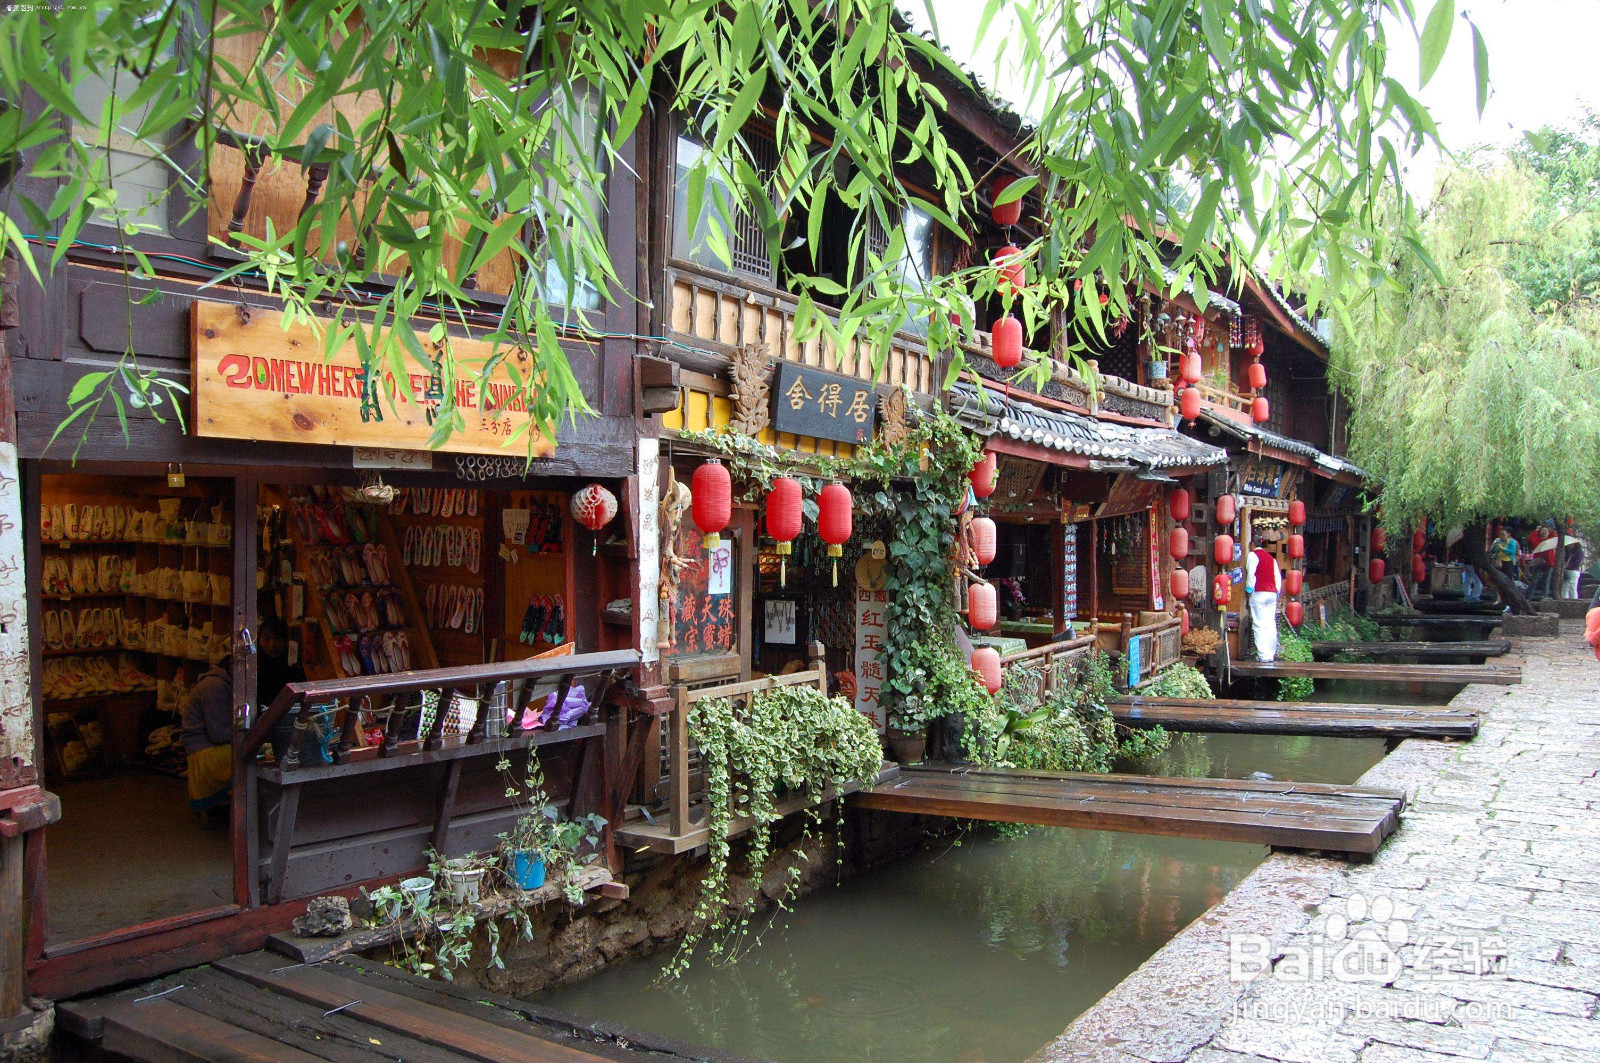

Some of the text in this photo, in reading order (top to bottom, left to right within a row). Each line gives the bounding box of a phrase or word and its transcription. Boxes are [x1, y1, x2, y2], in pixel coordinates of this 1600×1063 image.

[385, 371, 437, 405] OER
[453, 378, 477, 409] HE
[785, 373, 871, 423] 舍得居
[673, 592, 735, 626] 藏天珠
